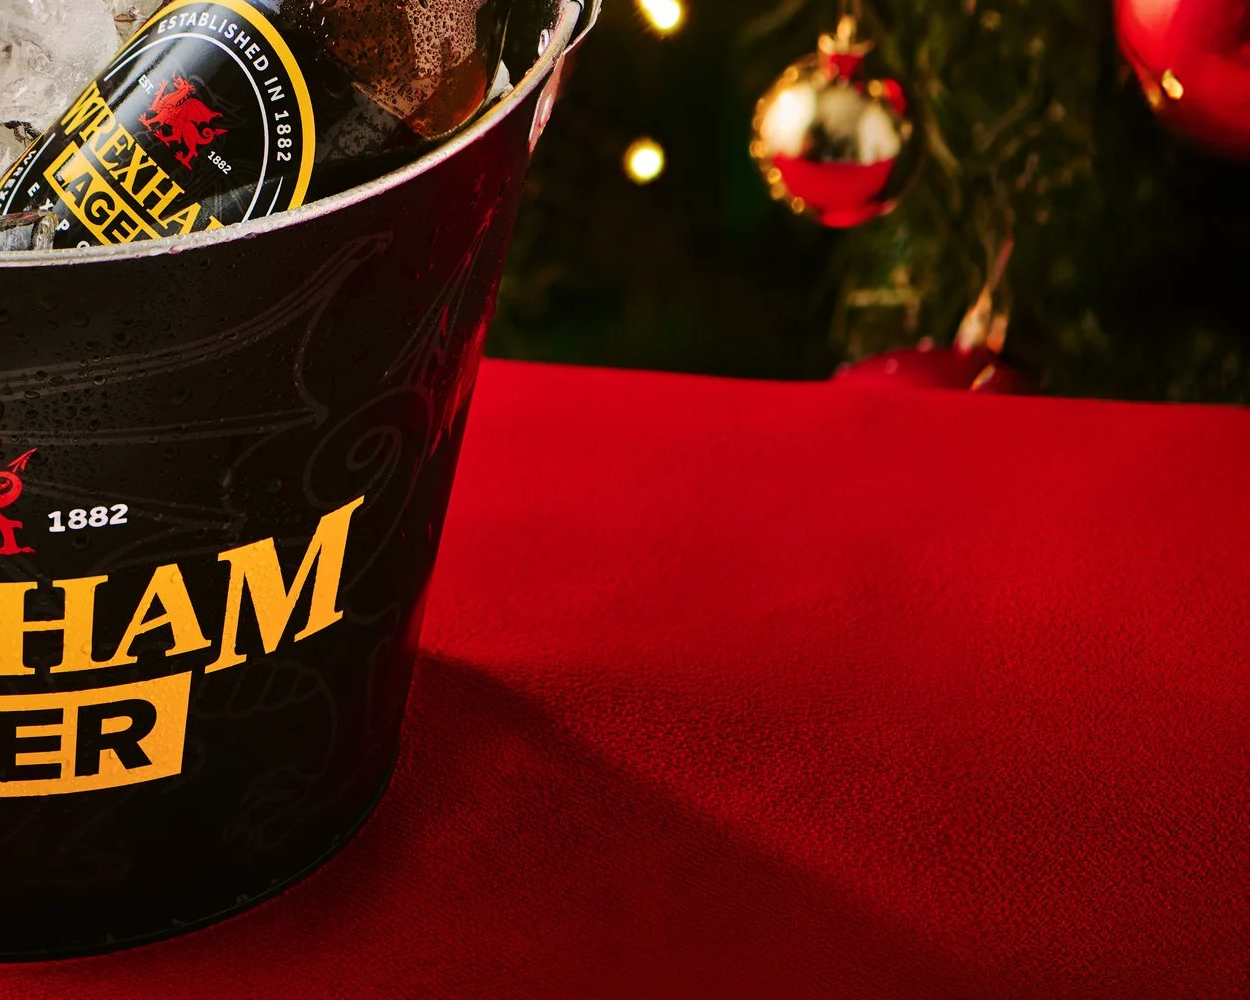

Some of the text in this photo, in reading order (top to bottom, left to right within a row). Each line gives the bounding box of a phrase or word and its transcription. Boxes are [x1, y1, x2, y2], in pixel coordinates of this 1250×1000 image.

[138, 73, 232, 175] EST. 1882
[157, 11, 292, 162] ESTABLISHED IN 1882
[48, 503, 128, 534] 1882
